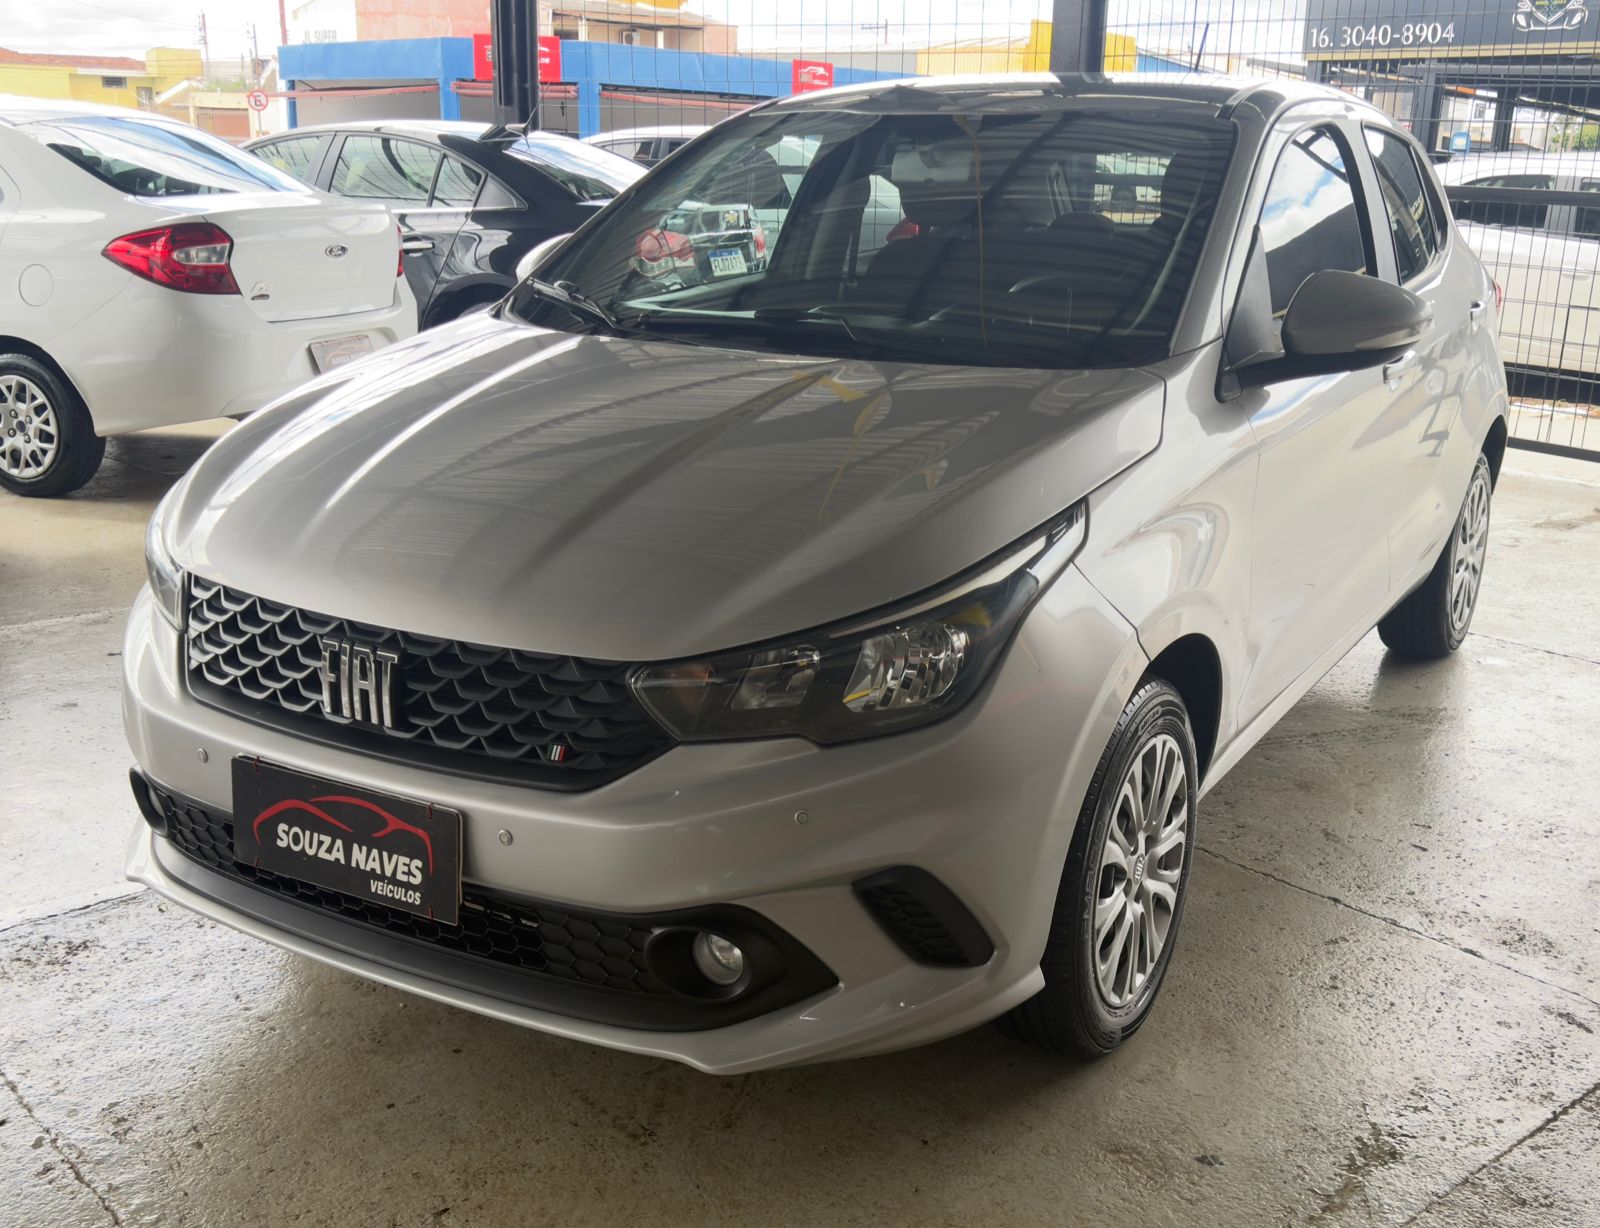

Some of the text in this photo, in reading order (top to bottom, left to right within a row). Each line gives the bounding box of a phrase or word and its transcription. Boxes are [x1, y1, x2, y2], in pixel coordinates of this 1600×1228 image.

[1310, 22, 1455, 48] 16. 3040-8904
[321, 637, 398, 728] FIAT
[276, 822, 423, 885] SOUZA NAVES
[370, 879, 422, 905] VEÍCULOS
